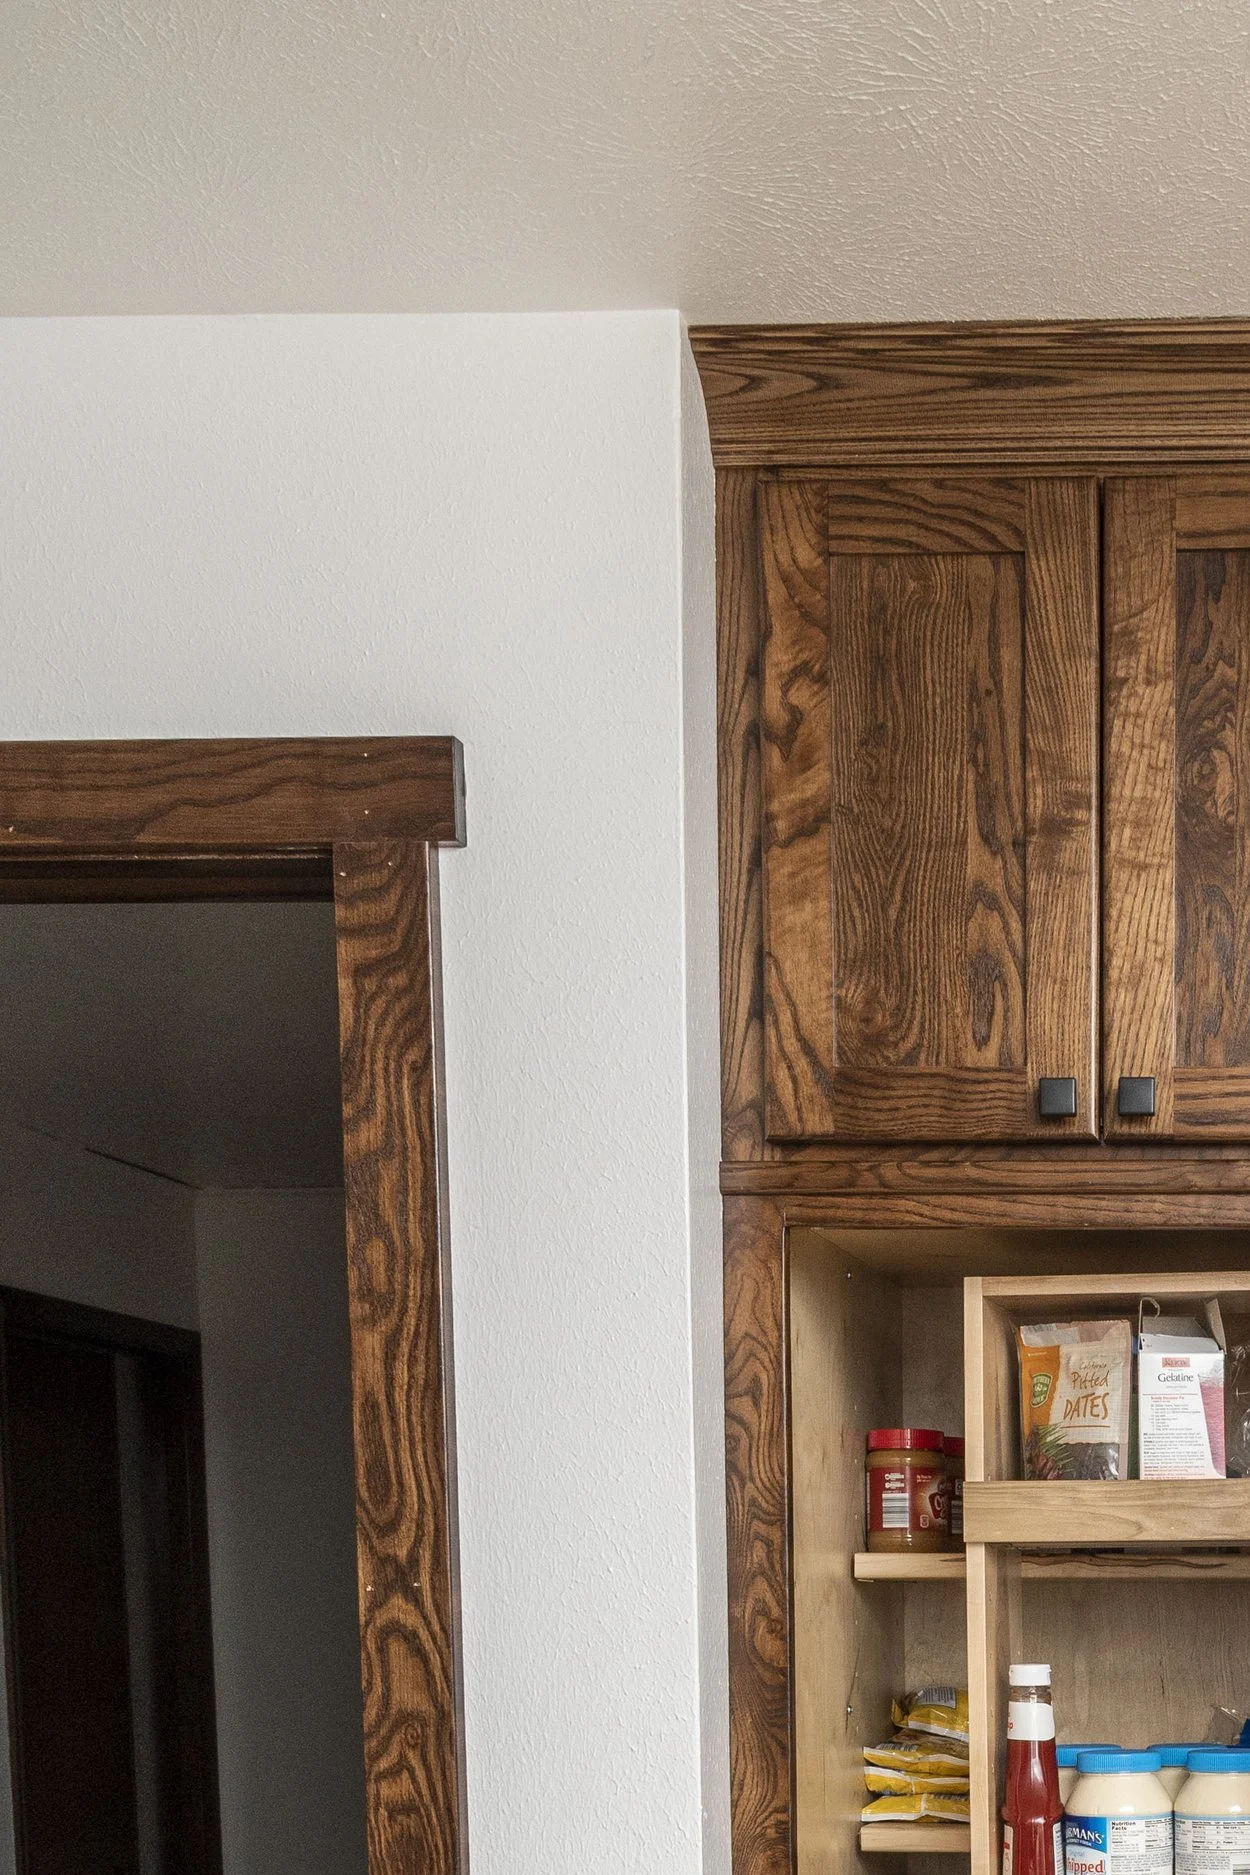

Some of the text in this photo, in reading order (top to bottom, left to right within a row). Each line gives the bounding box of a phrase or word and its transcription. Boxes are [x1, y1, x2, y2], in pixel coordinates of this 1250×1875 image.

[1070, 1370, 1110, 1390] Pitted
[1158, 1372, 1194, 1384] Gelatine
[1062, 1392, 1110, 1420] DATES
[1066, 1858, 1106, 1875] hipped
